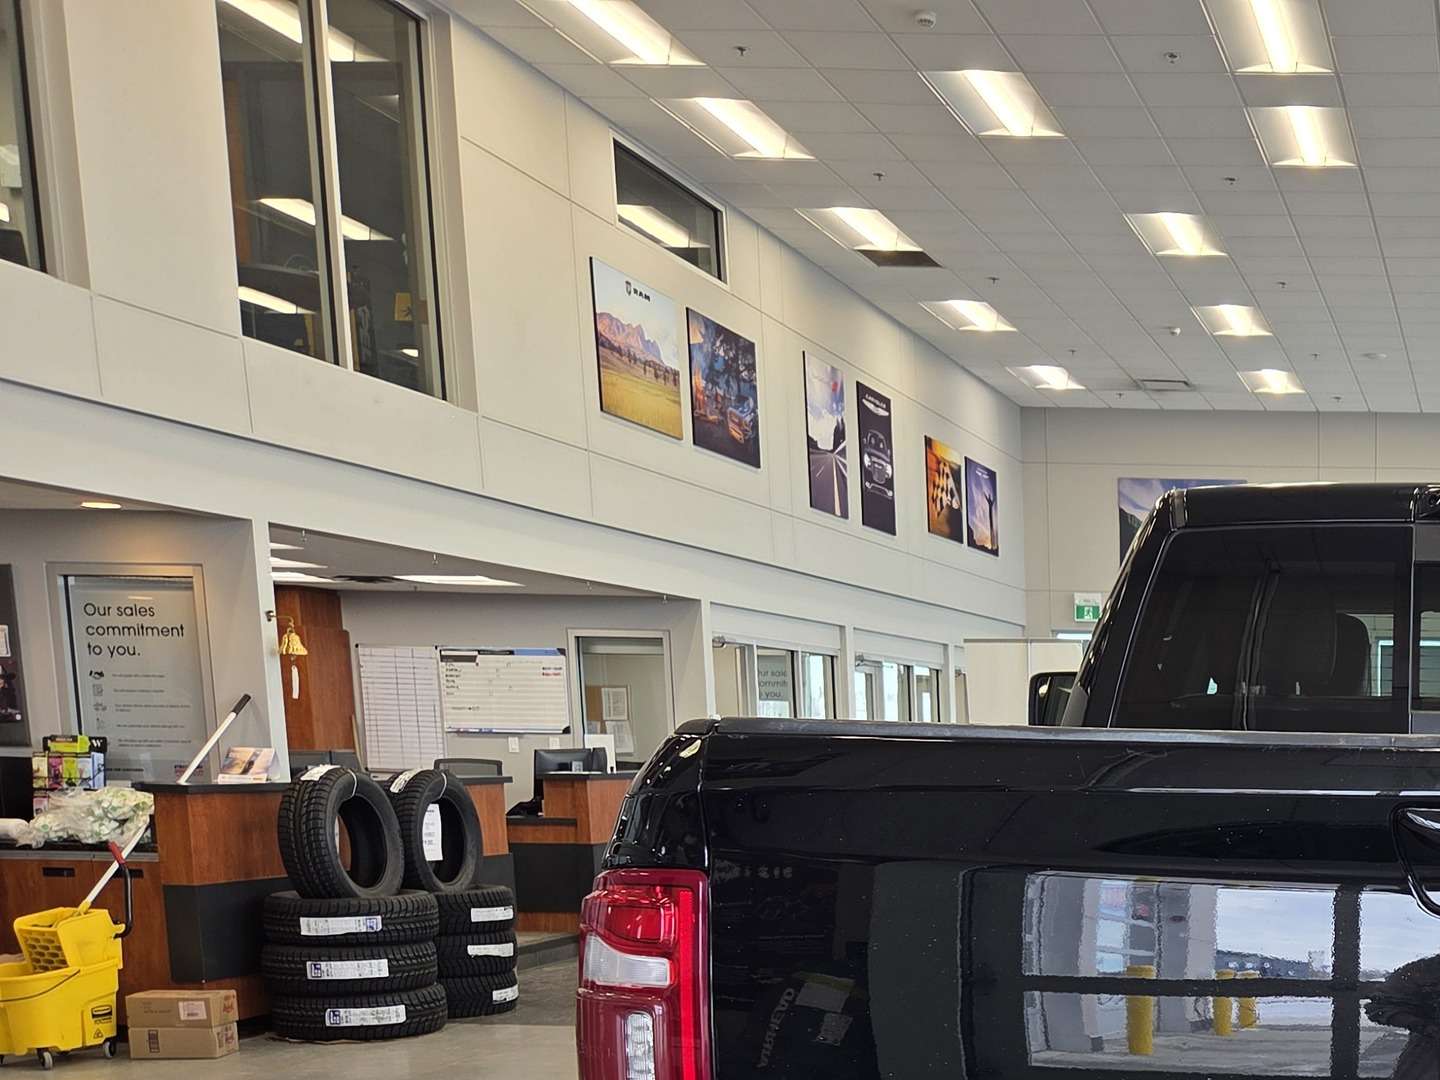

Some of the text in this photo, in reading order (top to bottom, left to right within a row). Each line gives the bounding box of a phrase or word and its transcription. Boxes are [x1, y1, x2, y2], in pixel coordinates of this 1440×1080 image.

[83, 602, 155, 617] Our sales
[85, 623, 184, 638] commitment
[87, 641, 141, 658] to you.
